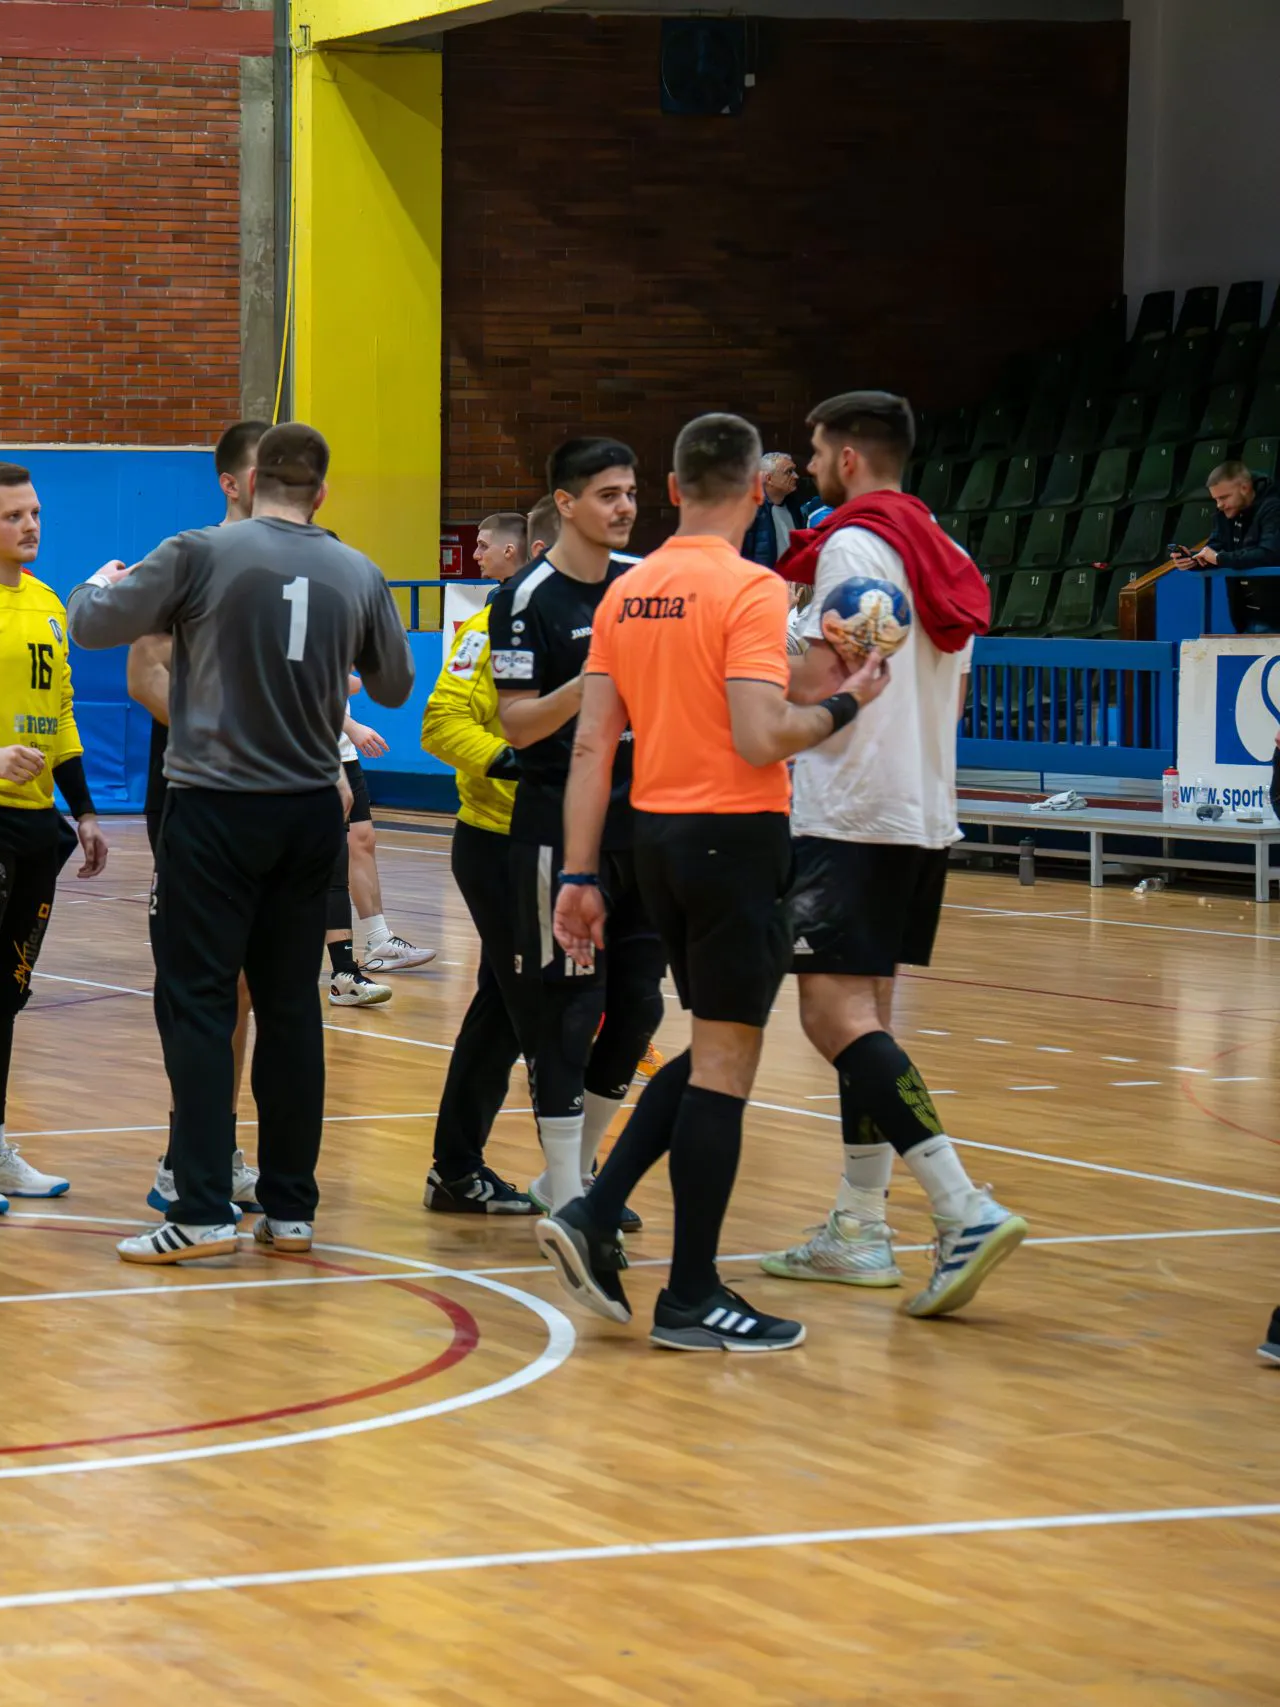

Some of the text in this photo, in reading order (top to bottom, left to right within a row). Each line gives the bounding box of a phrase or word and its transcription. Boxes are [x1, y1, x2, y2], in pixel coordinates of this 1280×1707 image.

[282, 575, 309, 662] 1
[617, 597, 687, 623] joma
[27, 642, 55, 691] 16
